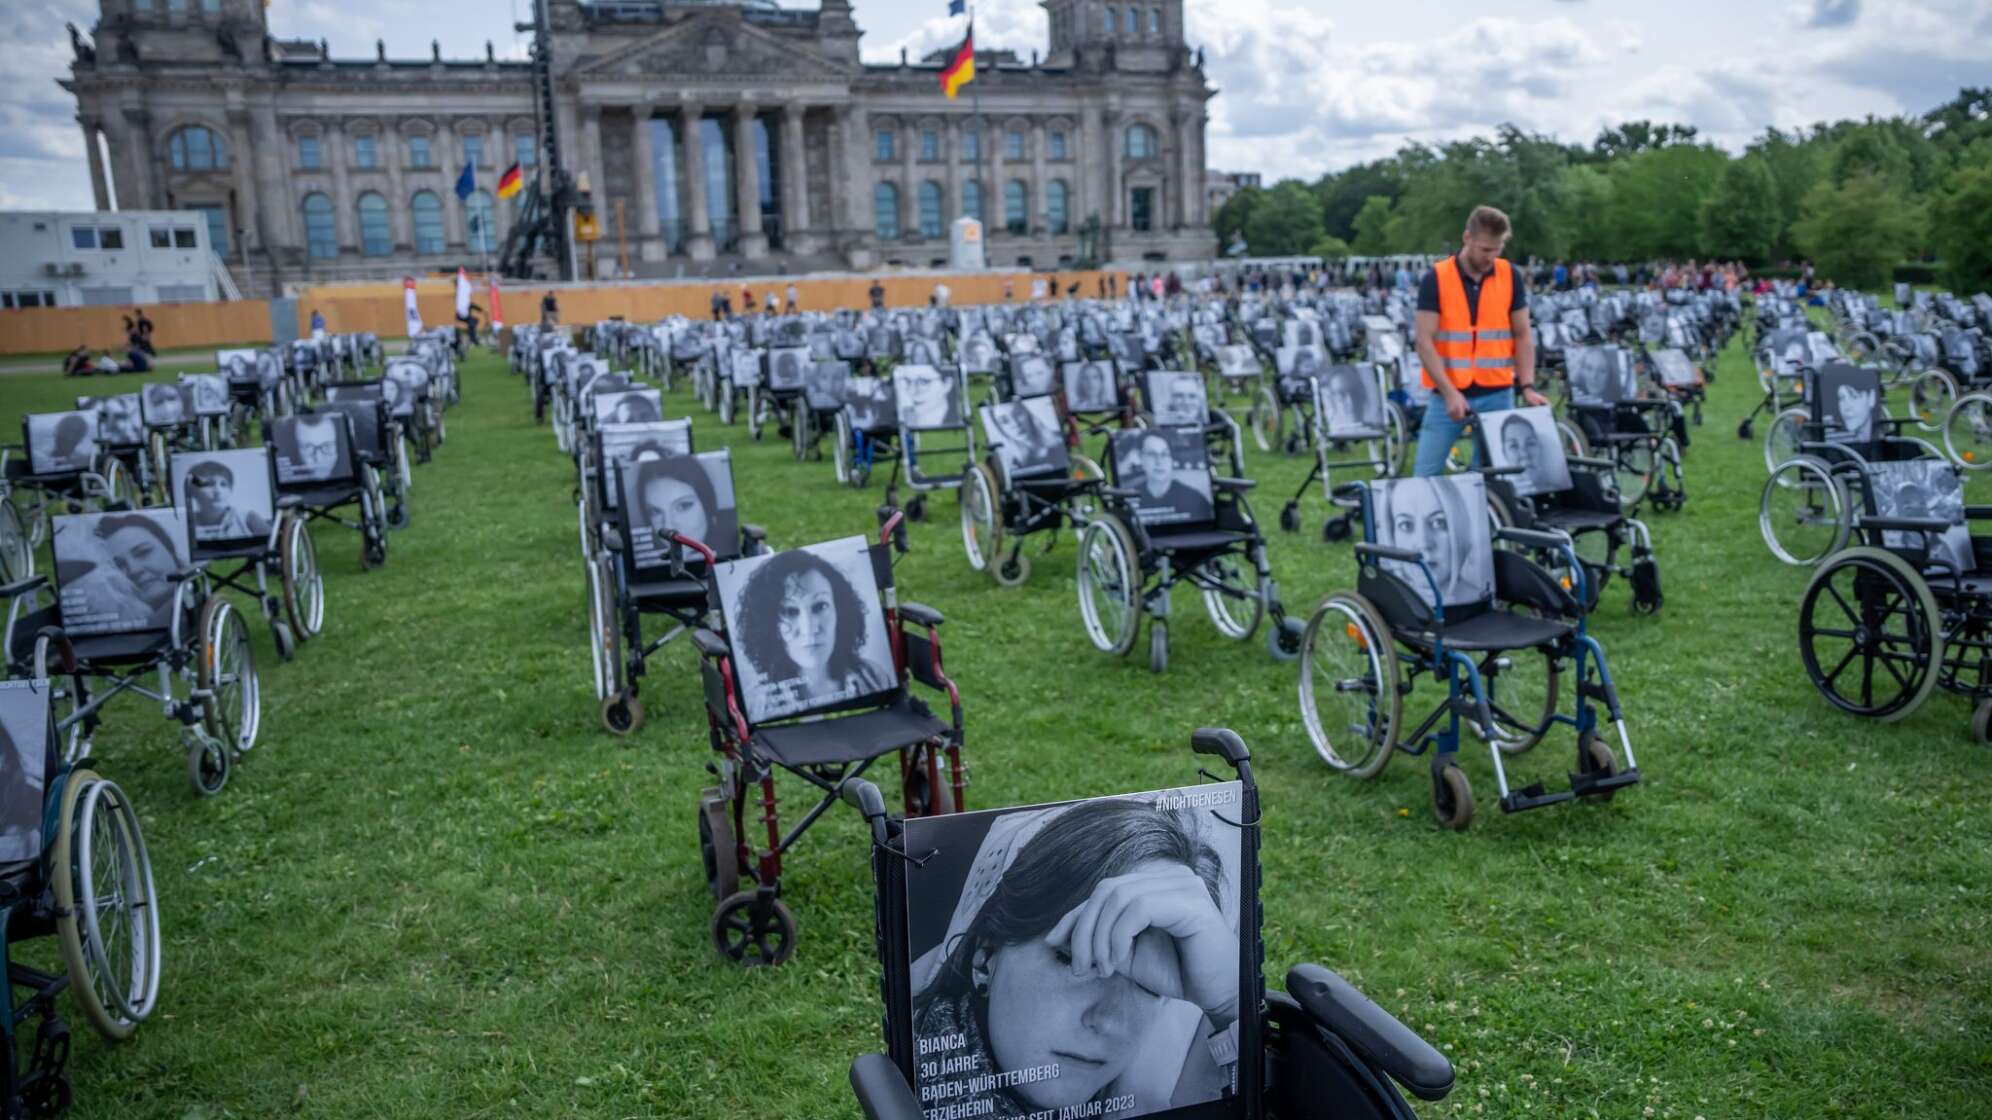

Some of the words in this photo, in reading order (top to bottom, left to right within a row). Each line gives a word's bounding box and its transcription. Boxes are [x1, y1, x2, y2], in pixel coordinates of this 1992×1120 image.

[1155, 789, 1236, 813] #NICHTGENESEN
[919, 1033, 966, 1055] BIANCA
[921, 1062, 937, 1079] 30
[941, 1054, 979, 1075] JAHRE
[921, 1063, 1060, 1101] BADEN-WÜRTTEMBERG
[1059, 1101, 1102, 1120] JANUAR
[1105, 1094, 1135, 1113] 2023
